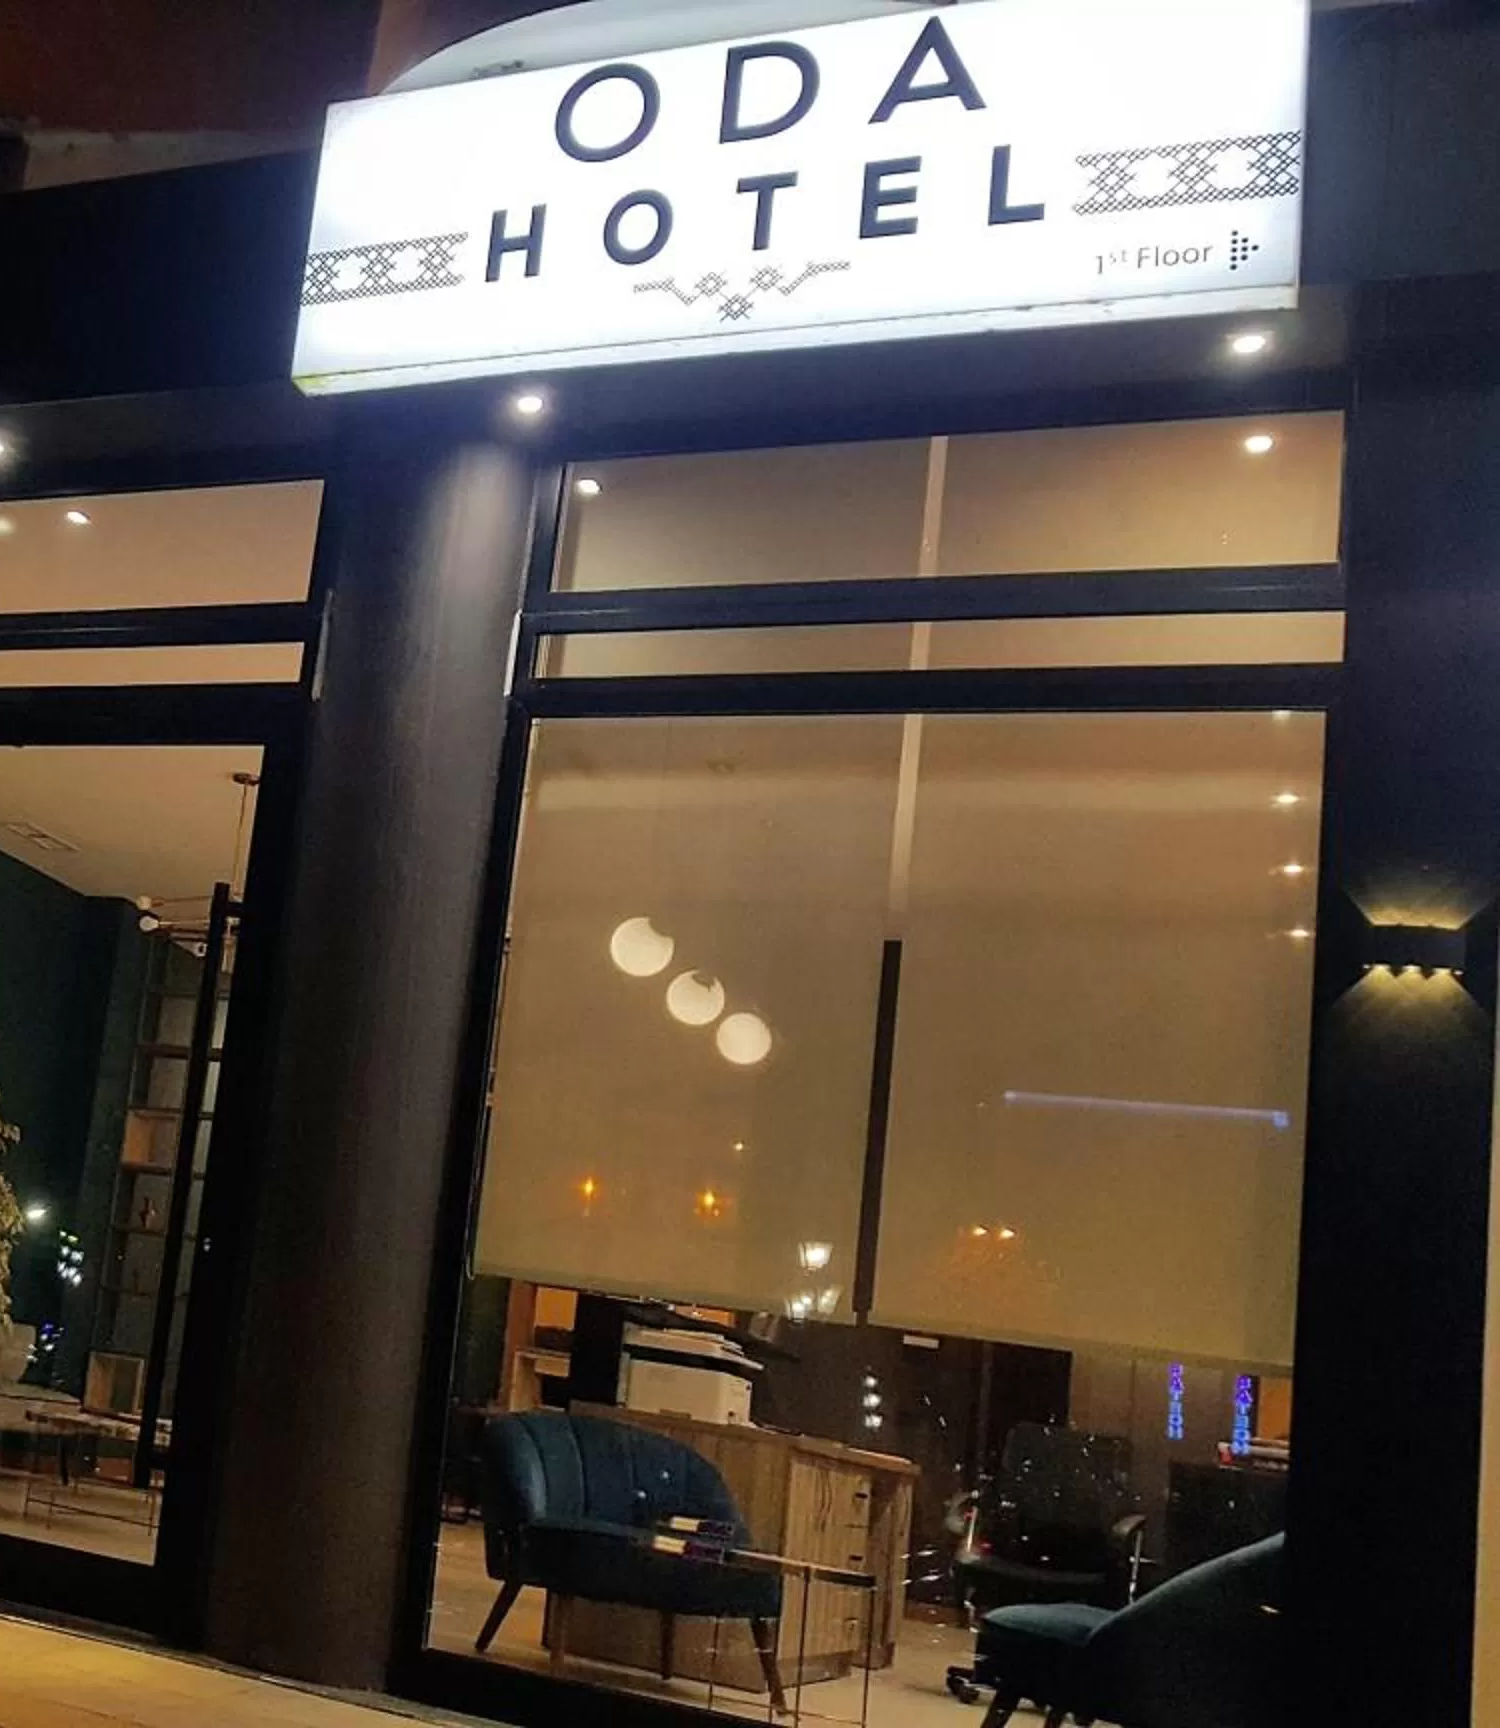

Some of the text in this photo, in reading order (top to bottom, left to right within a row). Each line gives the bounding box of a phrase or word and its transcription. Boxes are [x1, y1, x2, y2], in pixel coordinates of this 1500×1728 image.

[555, 16, 987, 163] ODA
[484, 144, 1045, 283] HOTEL
[1095, 243, 1215, 275] 1st Floor
